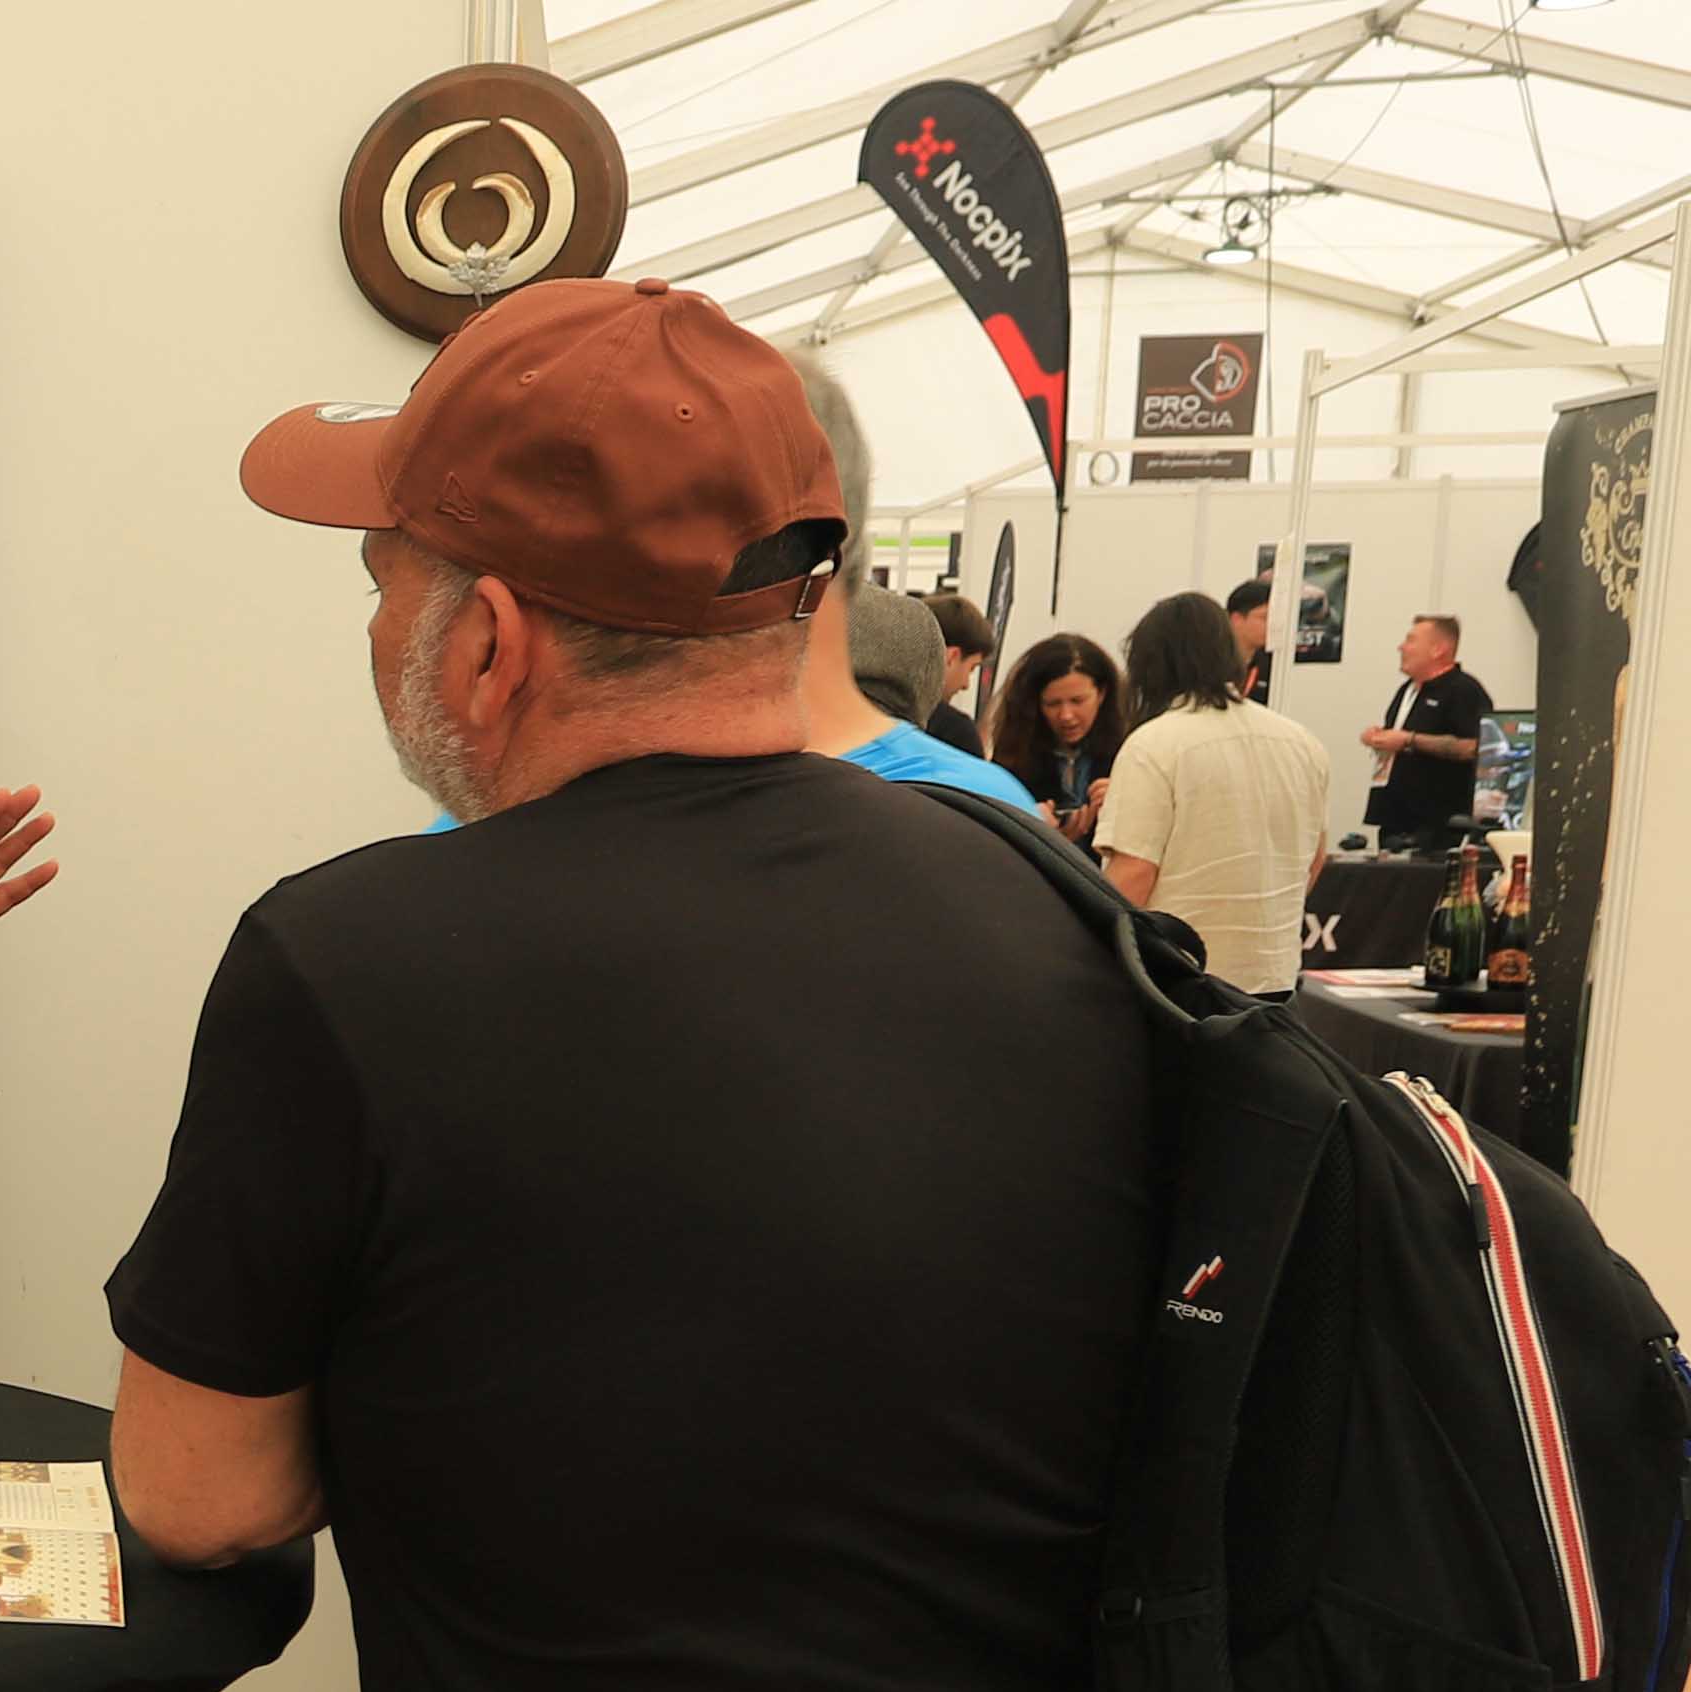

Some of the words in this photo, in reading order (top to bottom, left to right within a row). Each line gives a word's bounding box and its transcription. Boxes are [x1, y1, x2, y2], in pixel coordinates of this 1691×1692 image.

[932, 159, 1032, 283] Nocpix
[1143, 394, 1202, 412] PRO
[1142, 410, 1235, 431] CACCIA
